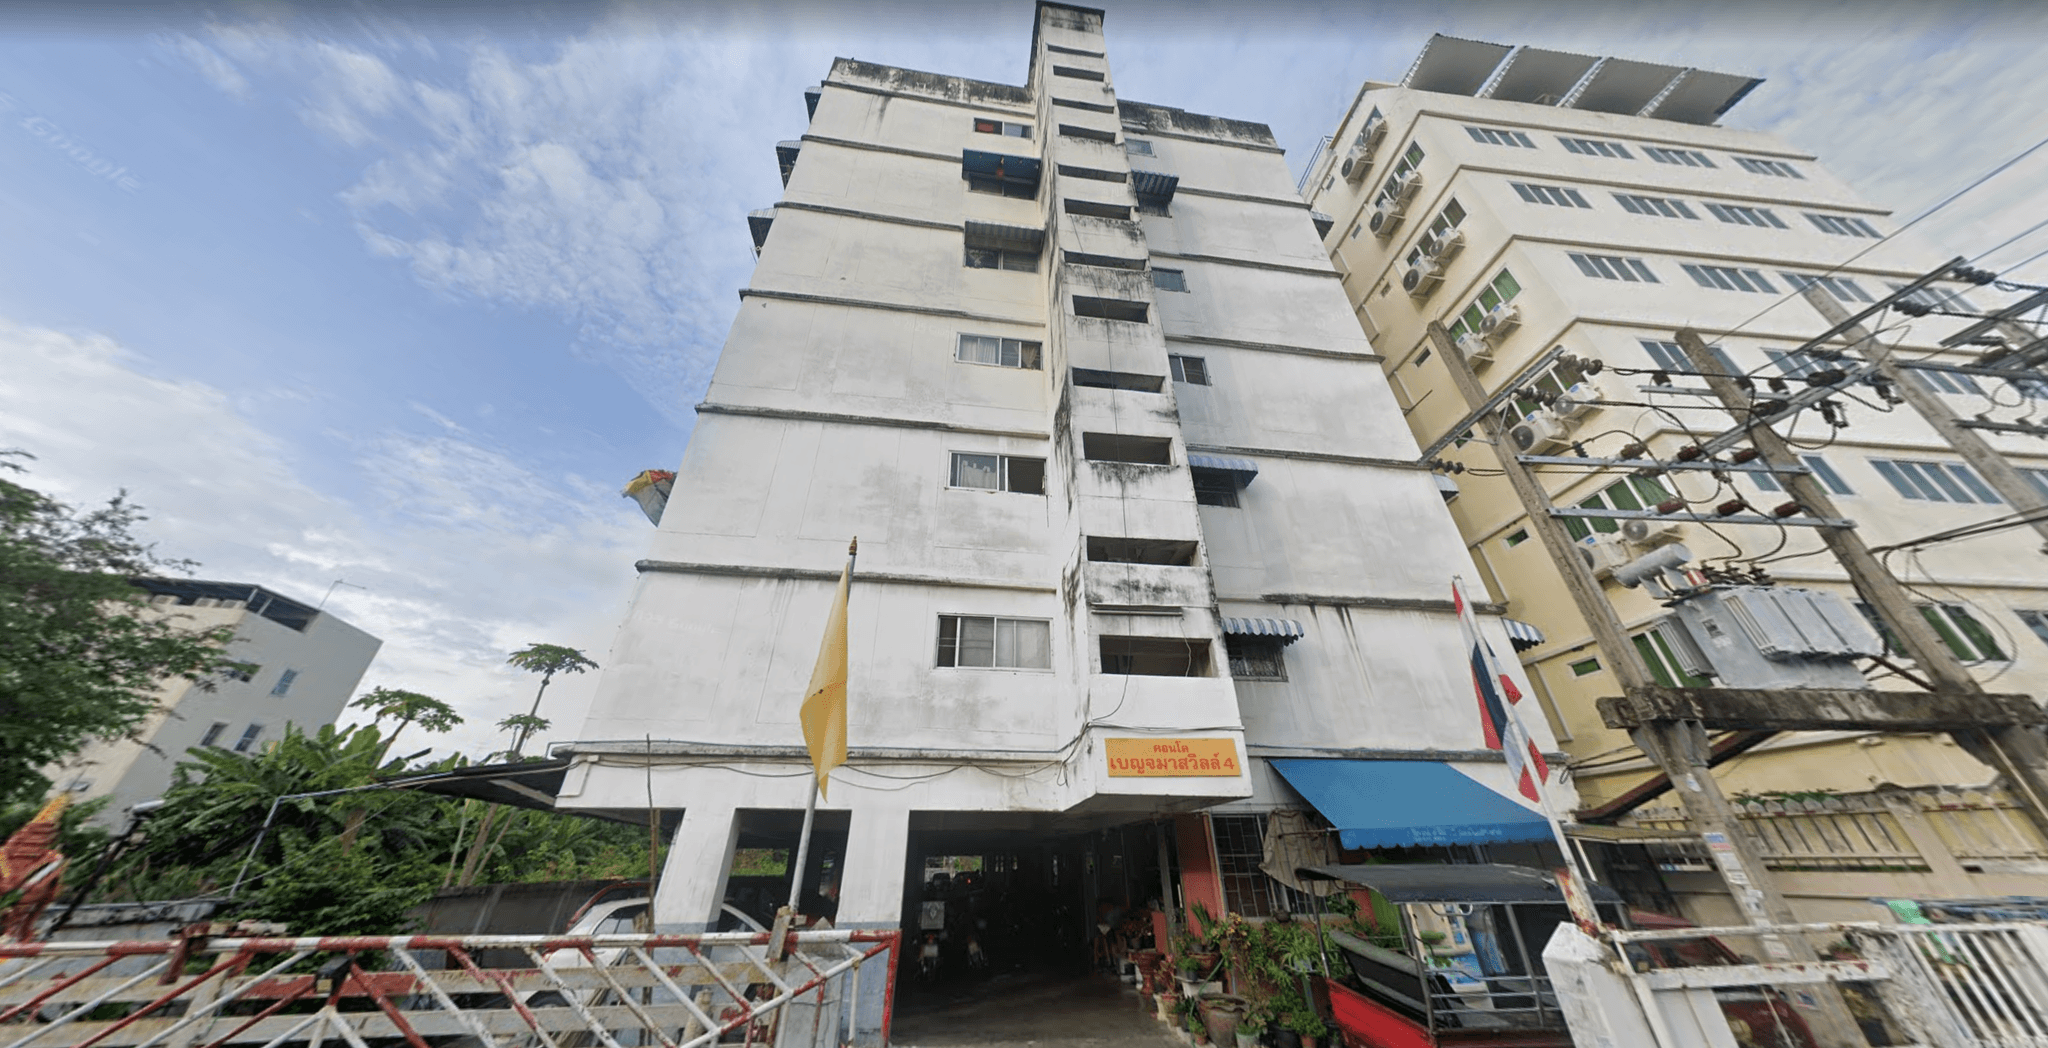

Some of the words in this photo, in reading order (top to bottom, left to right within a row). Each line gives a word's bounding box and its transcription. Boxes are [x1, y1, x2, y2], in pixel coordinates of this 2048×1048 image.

[1153, 740, 1190, 753] คอนโด
[1110, 752, 1221, 774] เบญจมาสวิลล์
[1223, 757, 1235, 770] 4
